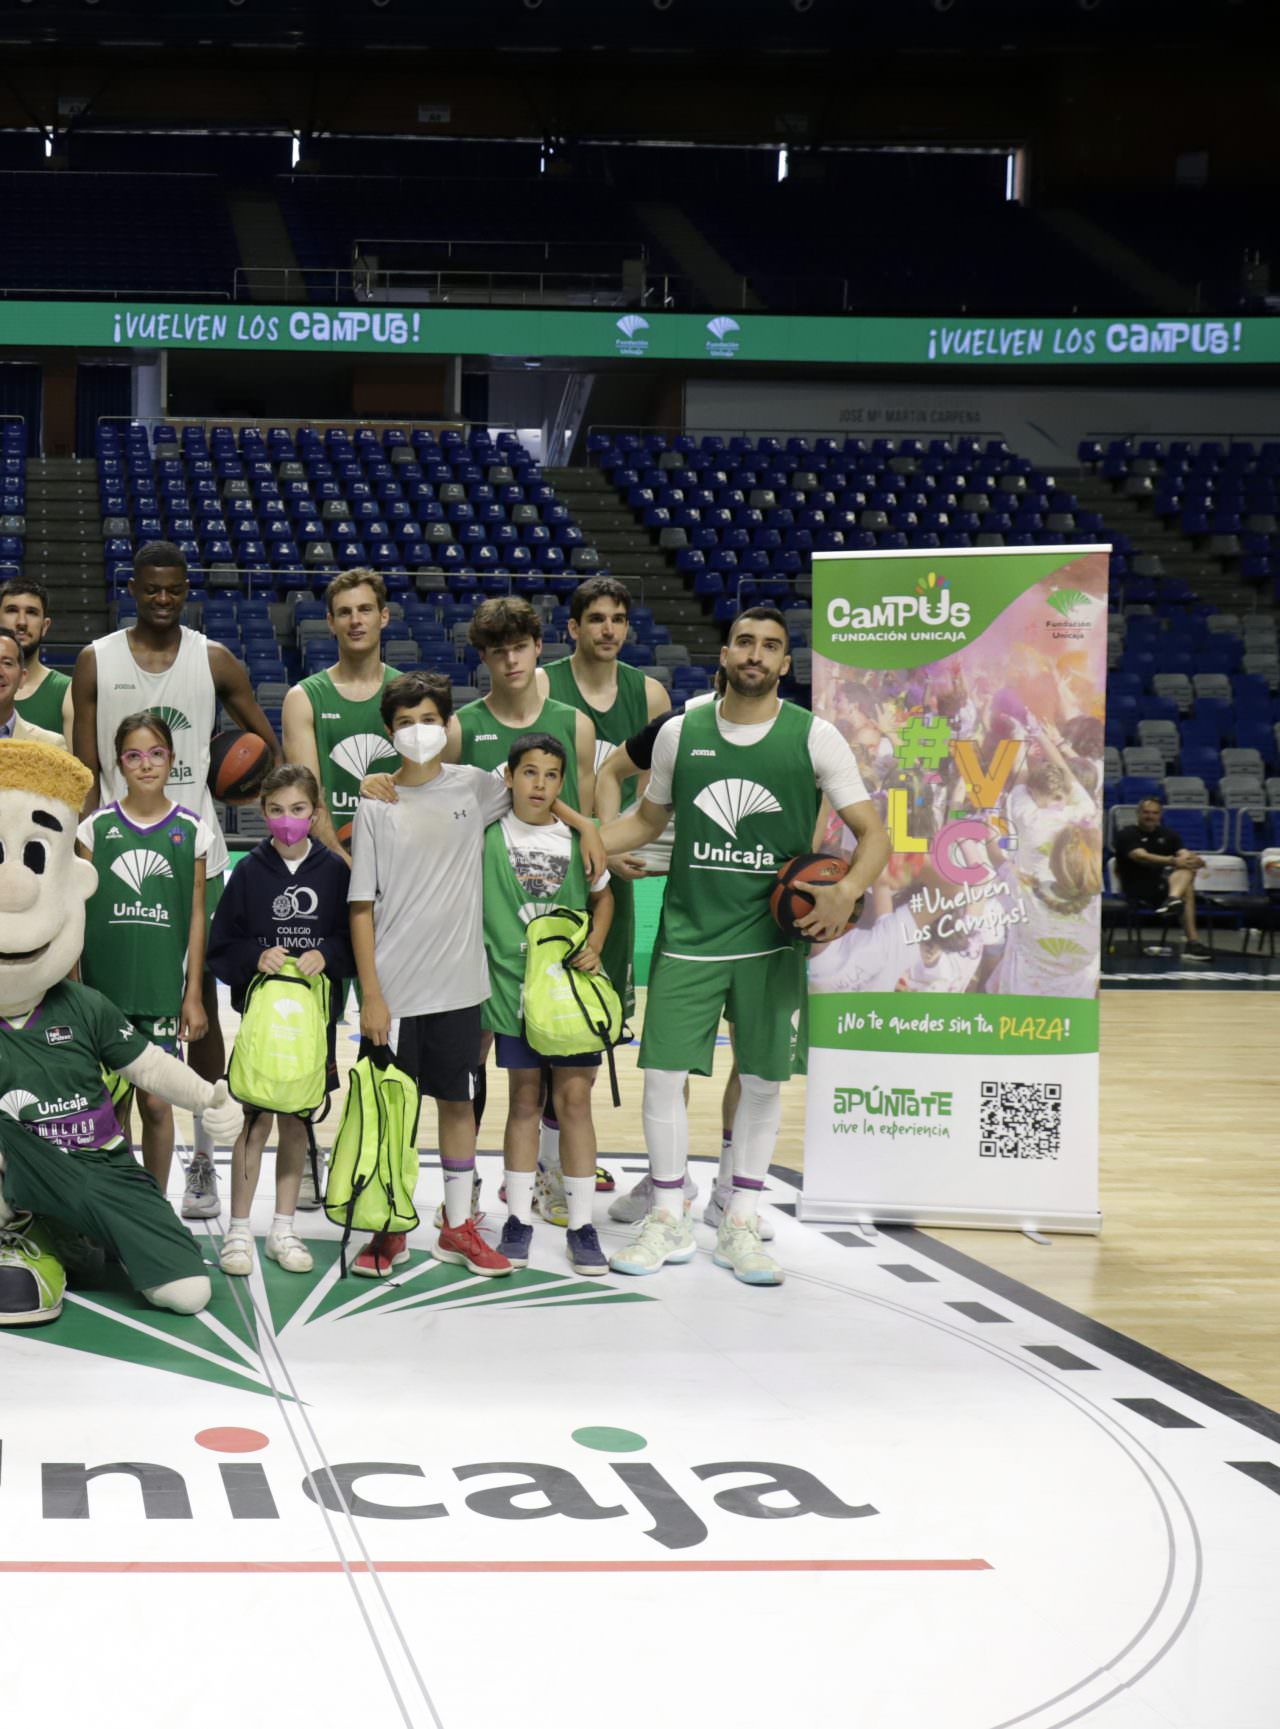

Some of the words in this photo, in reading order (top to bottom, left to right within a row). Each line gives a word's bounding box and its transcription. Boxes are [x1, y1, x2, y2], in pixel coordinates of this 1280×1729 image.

[113, 312, 227, 343] ¡VUELVEN
[237, 314, 279, 341] LOS
[928, 327, 1043, 360] ¡VUELVEN
[1053, 328, 1096, 354] LOS
[831, 631, 907, 642] FUNDACIÓN
[910, 631, 966, 642] UNICAJA
[693, 839, 775, 869] Unicaja
[113, 900, 169, 922] Unicaja
[910, 881, 1010, 919] #Vuelven
[277, 926, 311, 935] COLEGIO
[901, 923, 931, 945] Los
[938, 898, 1029, 939] Campus!
[868, 1011, 883, 1030] te
[889, 1016, 944, 1035] quedes
[948, 1016, 971, 1034] sin
[974, 1013, 993, 1033] tu
[38, 1093, 88, 1115] Unicaja
[832, 1121, 859, 1135] vive
[863, 1119, 875, 1136] la
[879, 1120, 951, 1140] experiencia
